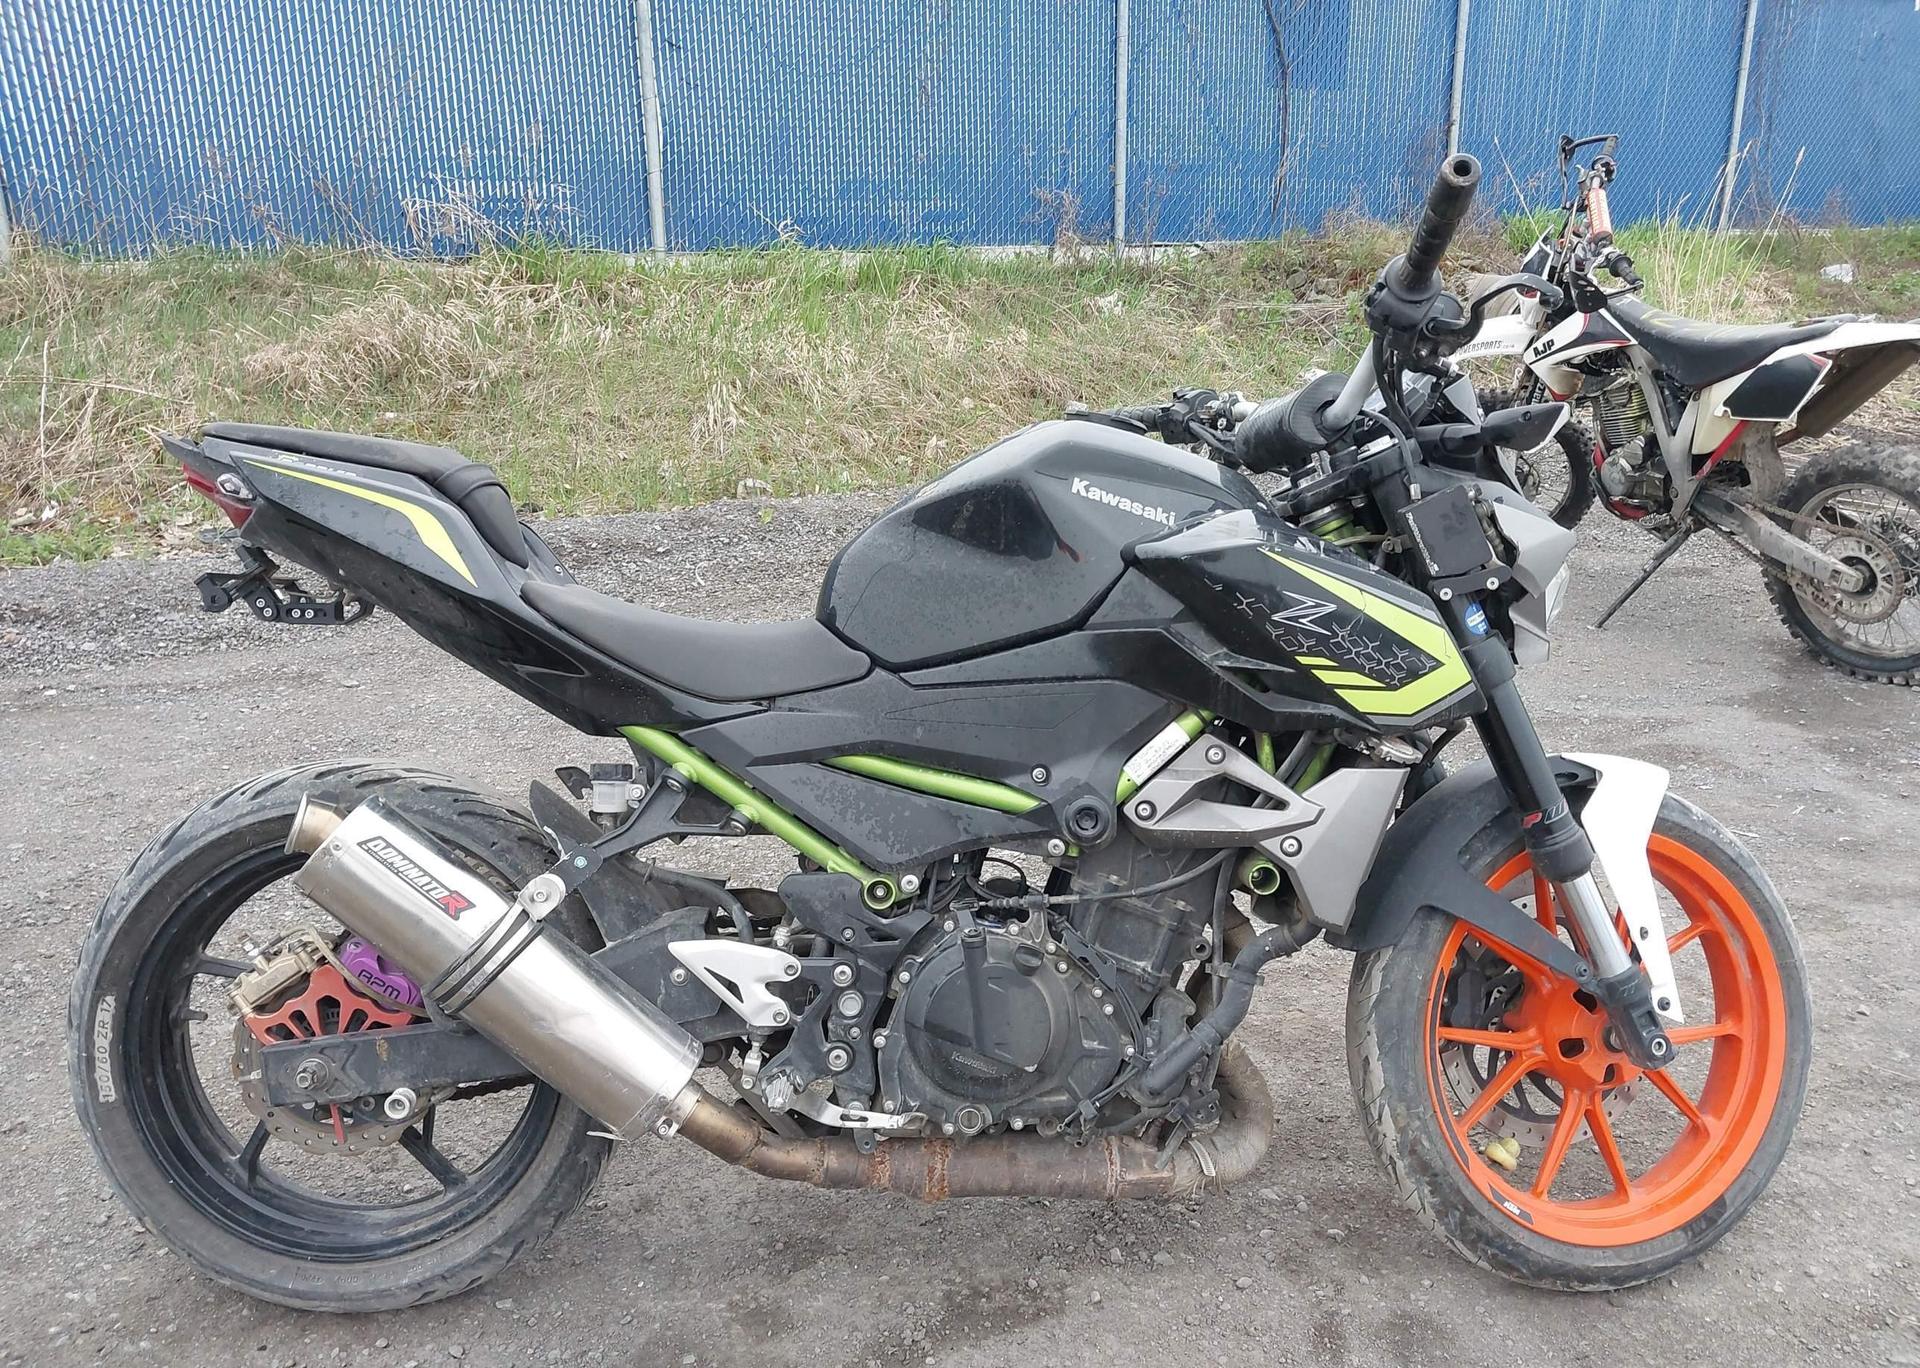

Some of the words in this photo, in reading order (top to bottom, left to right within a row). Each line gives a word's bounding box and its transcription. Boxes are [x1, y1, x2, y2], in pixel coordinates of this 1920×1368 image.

[1533, 339, 1555, 358] AJP
[1071, 477, 1176, 526] Kawasaki
[365, 839, 470, 916] DOMINATOR
[358, 969, 400, 1000] RPM
[101, 998, 112, 1013] 17
[97, 1019, 109, 1041] ZR
